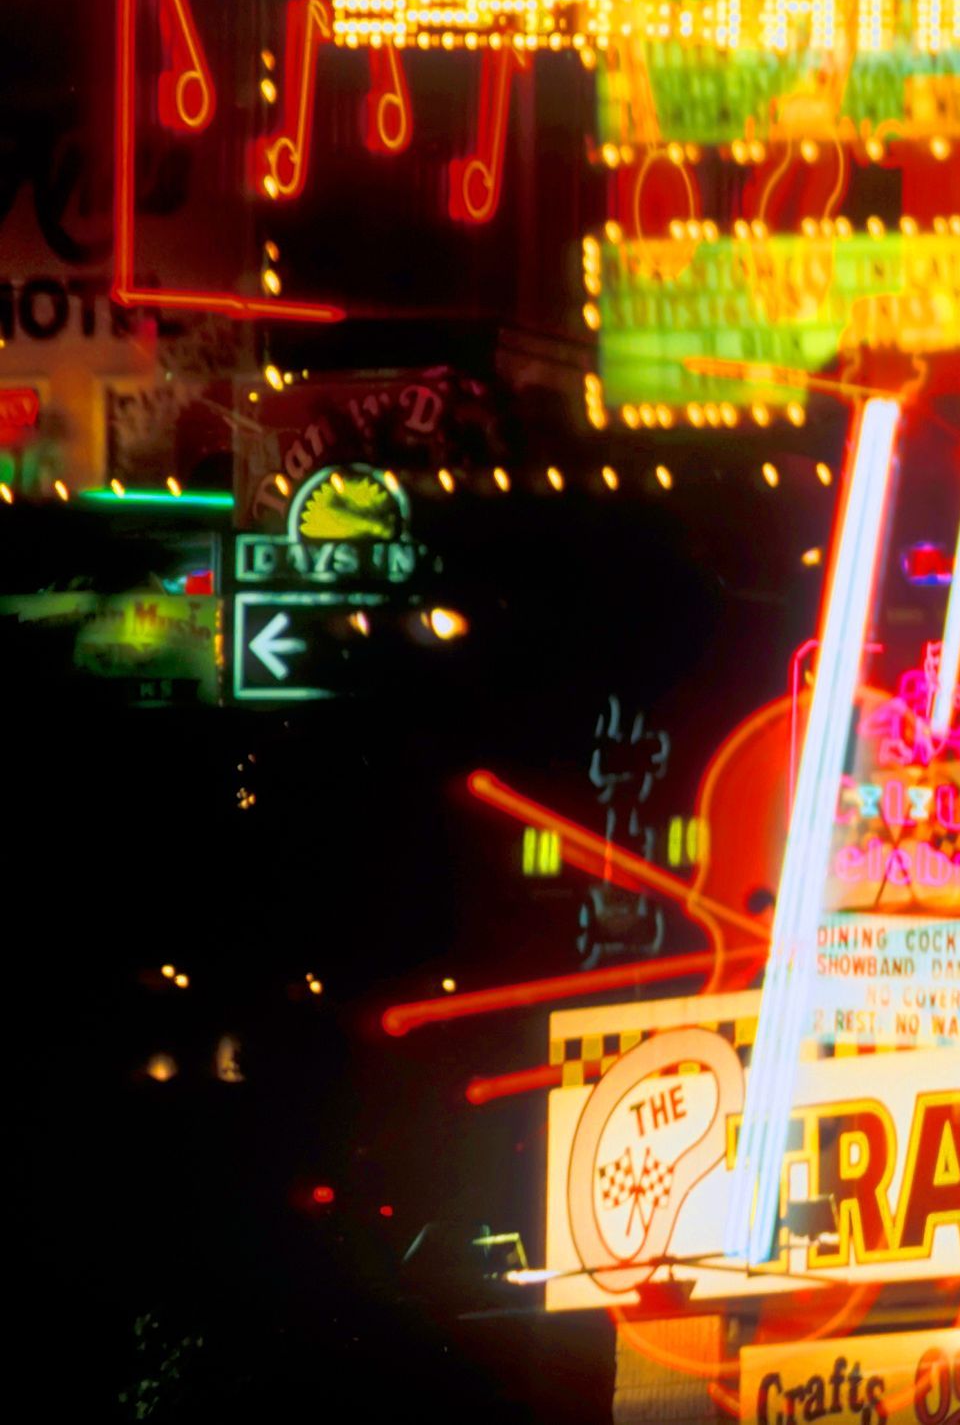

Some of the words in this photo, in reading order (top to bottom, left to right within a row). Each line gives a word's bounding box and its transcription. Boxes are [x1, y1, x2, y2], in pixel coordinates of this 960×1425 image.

[816, 924, 888, 951] DINING
[815, 953, 916, 978] SHOWBAND
[895, 1010, 921, 1036] NO
[629, 1084, 688, 1138] THE
